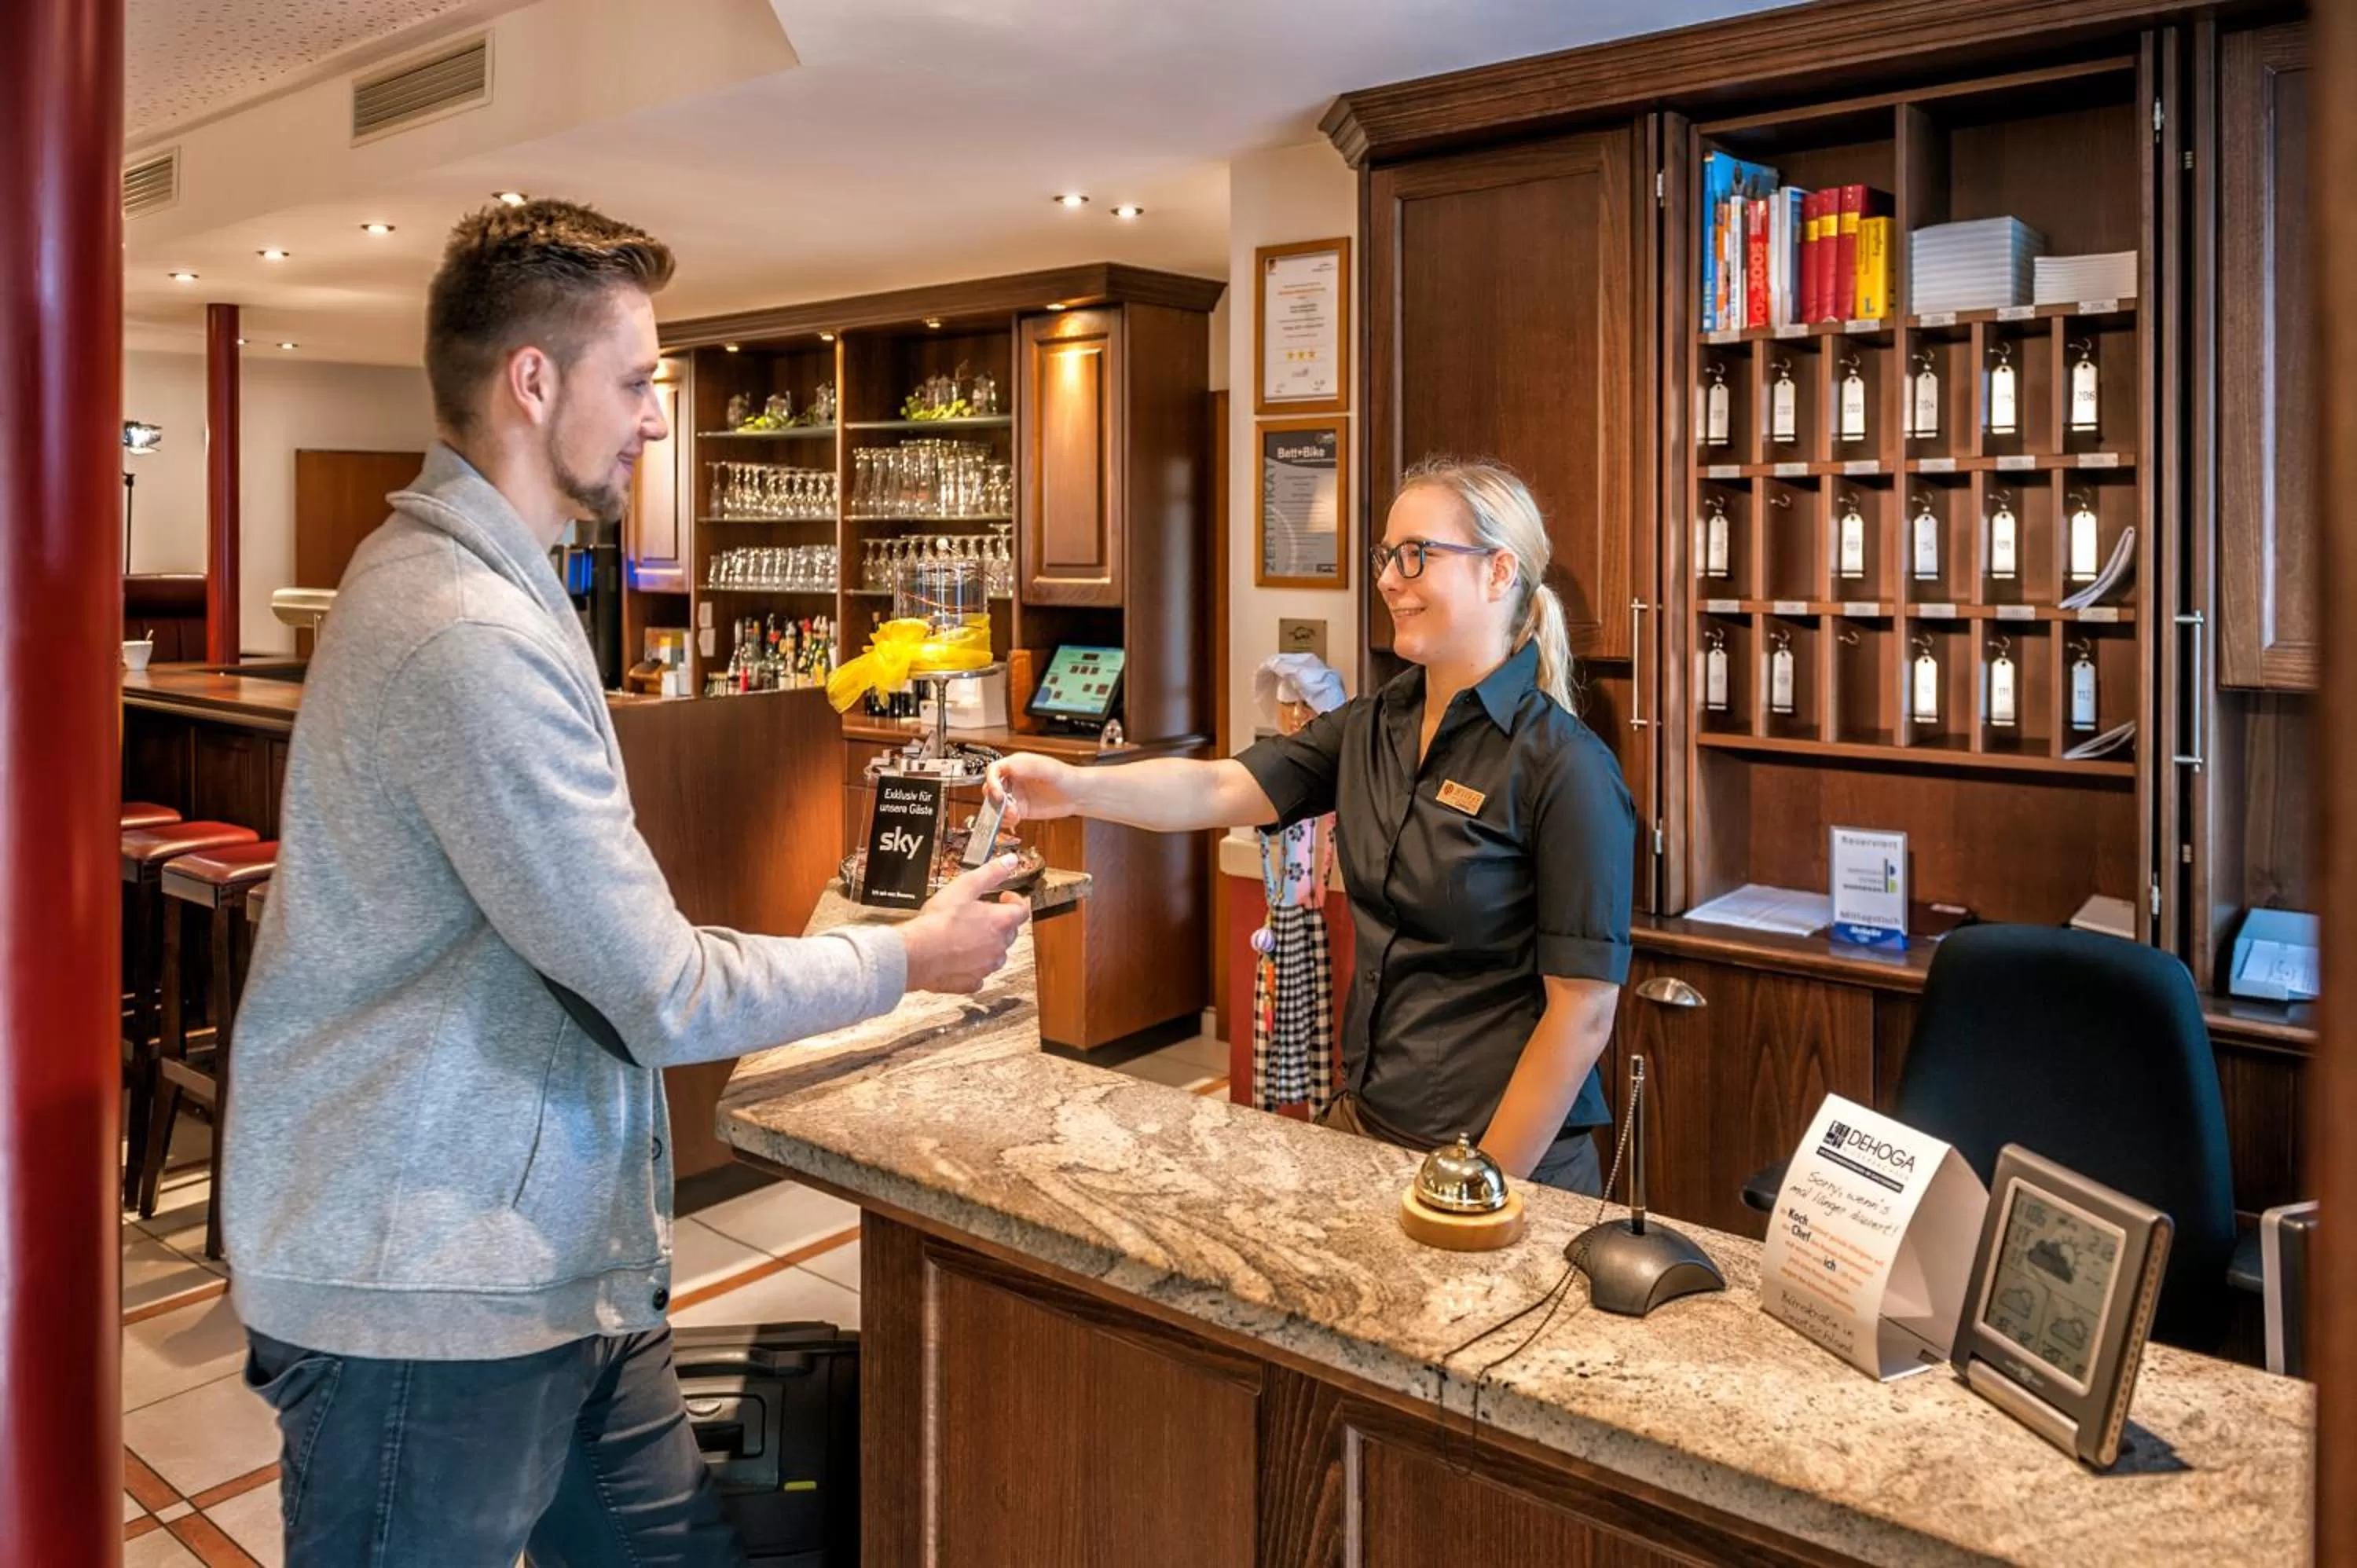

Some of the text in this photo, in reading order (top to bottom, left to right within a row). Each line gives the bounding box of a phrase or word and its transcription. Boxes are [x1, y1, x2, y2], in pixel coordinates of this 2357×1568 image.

[884, 788, 933, 802] Exklusiv für
[879, 804, 933, 815] unsere Gäste
[879, 826, 924, 860] sky
[1847, 1129, 1915, 1174] DEHOGA
[1787, 1207, 1809, 1225] Koch
[1823, 1255, 1837, 1271] ich
